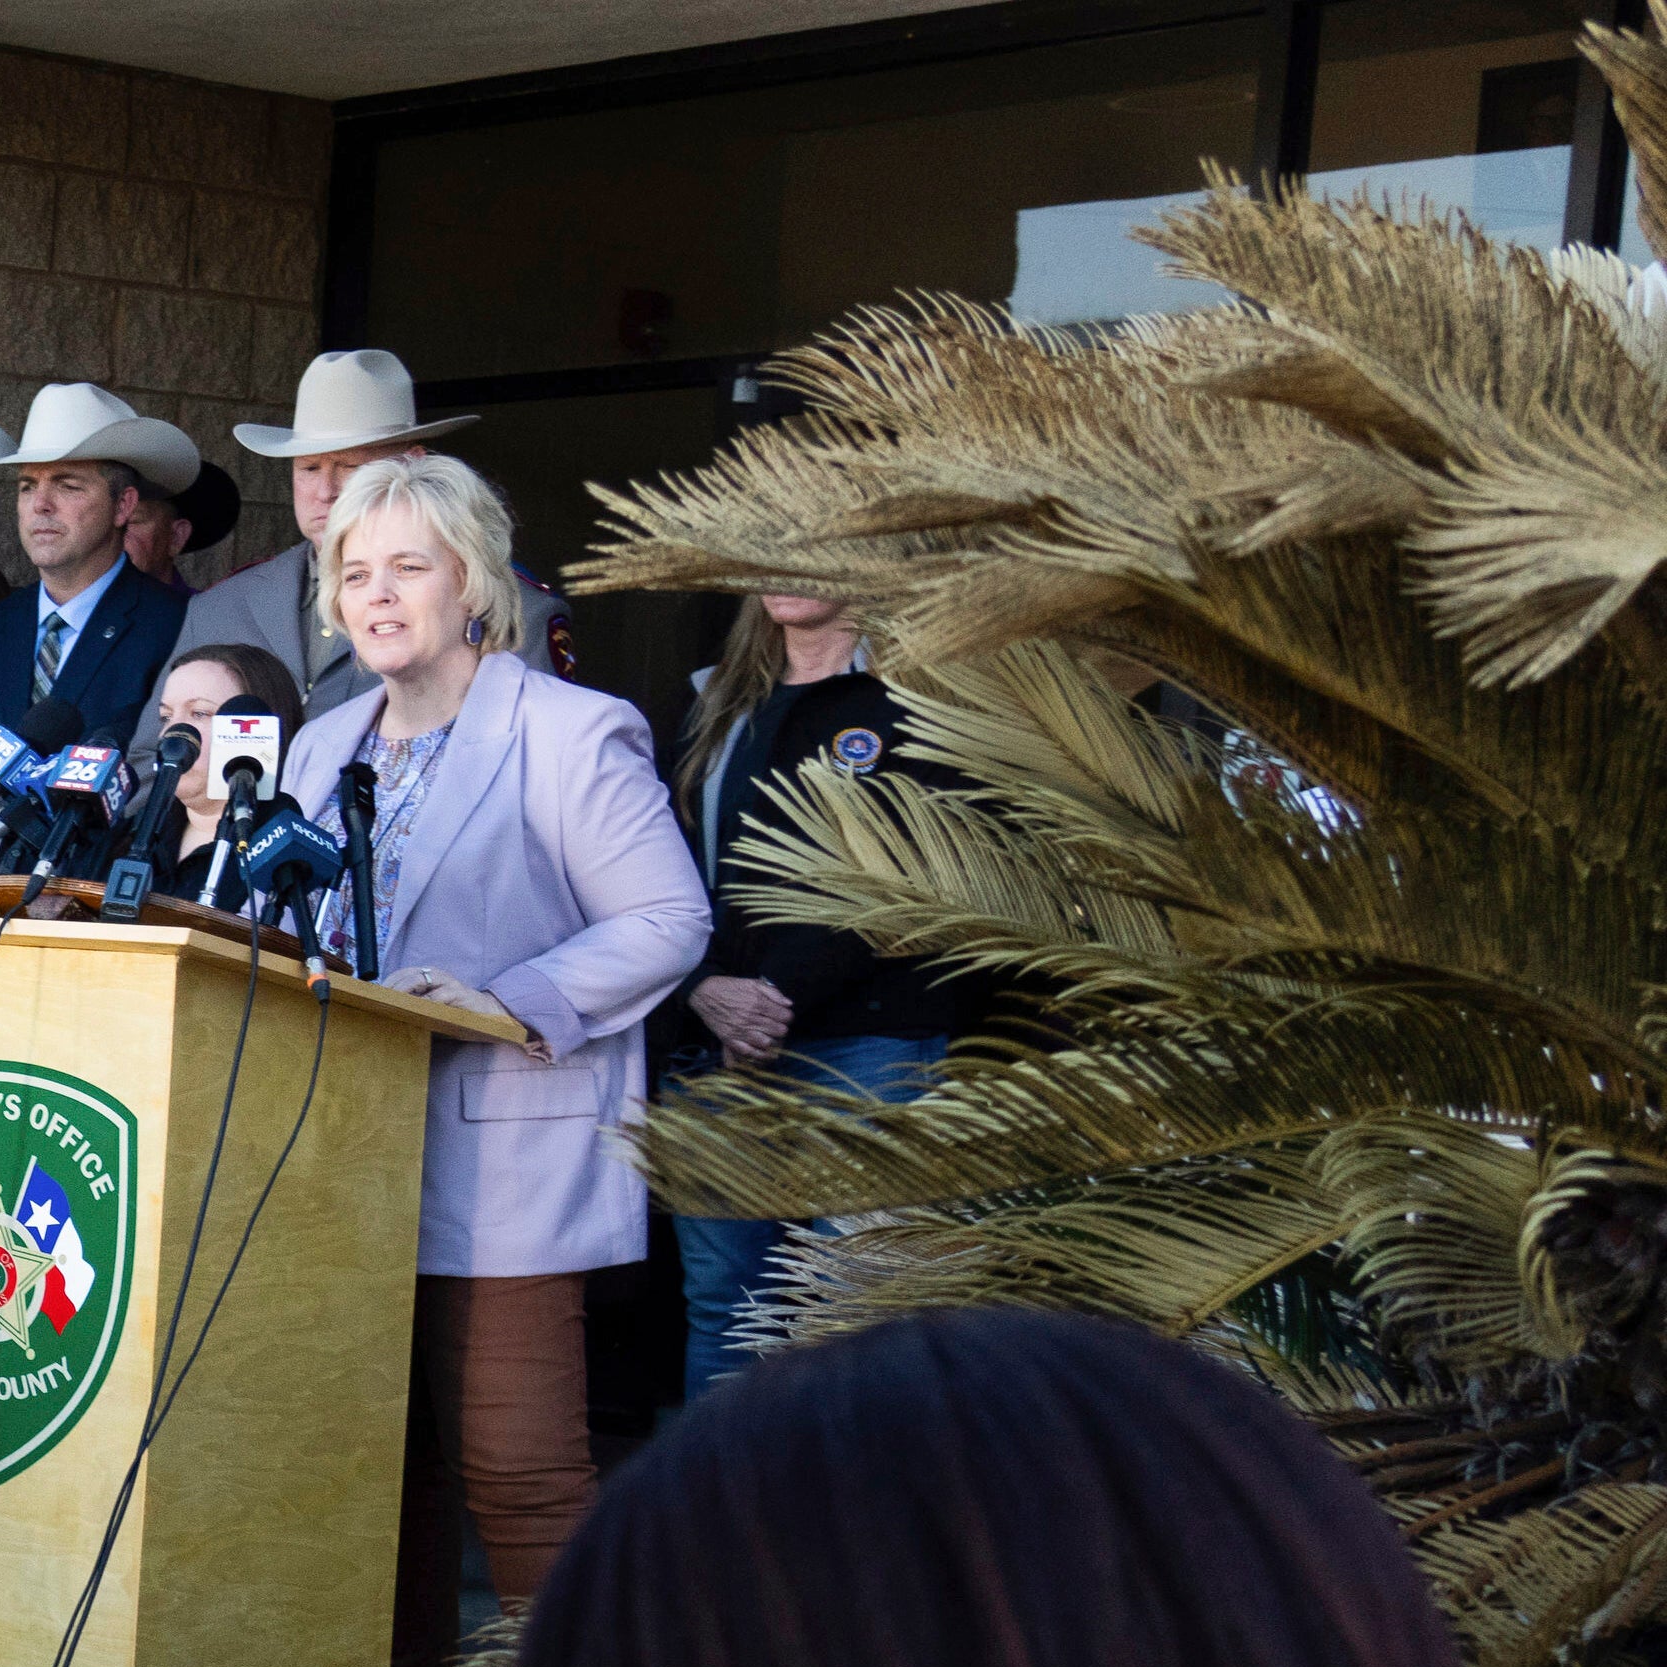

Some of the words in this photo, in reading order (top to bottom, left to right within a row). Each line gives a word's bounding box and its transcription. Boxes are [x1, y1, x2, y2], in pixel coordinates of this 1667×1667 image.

[73, 746, 108, 761] FOX
[59, 760, 100, 782] 26
[29, 1103, 116, 1201] OFFICE
[0, 1253, 15, 1270] OF
